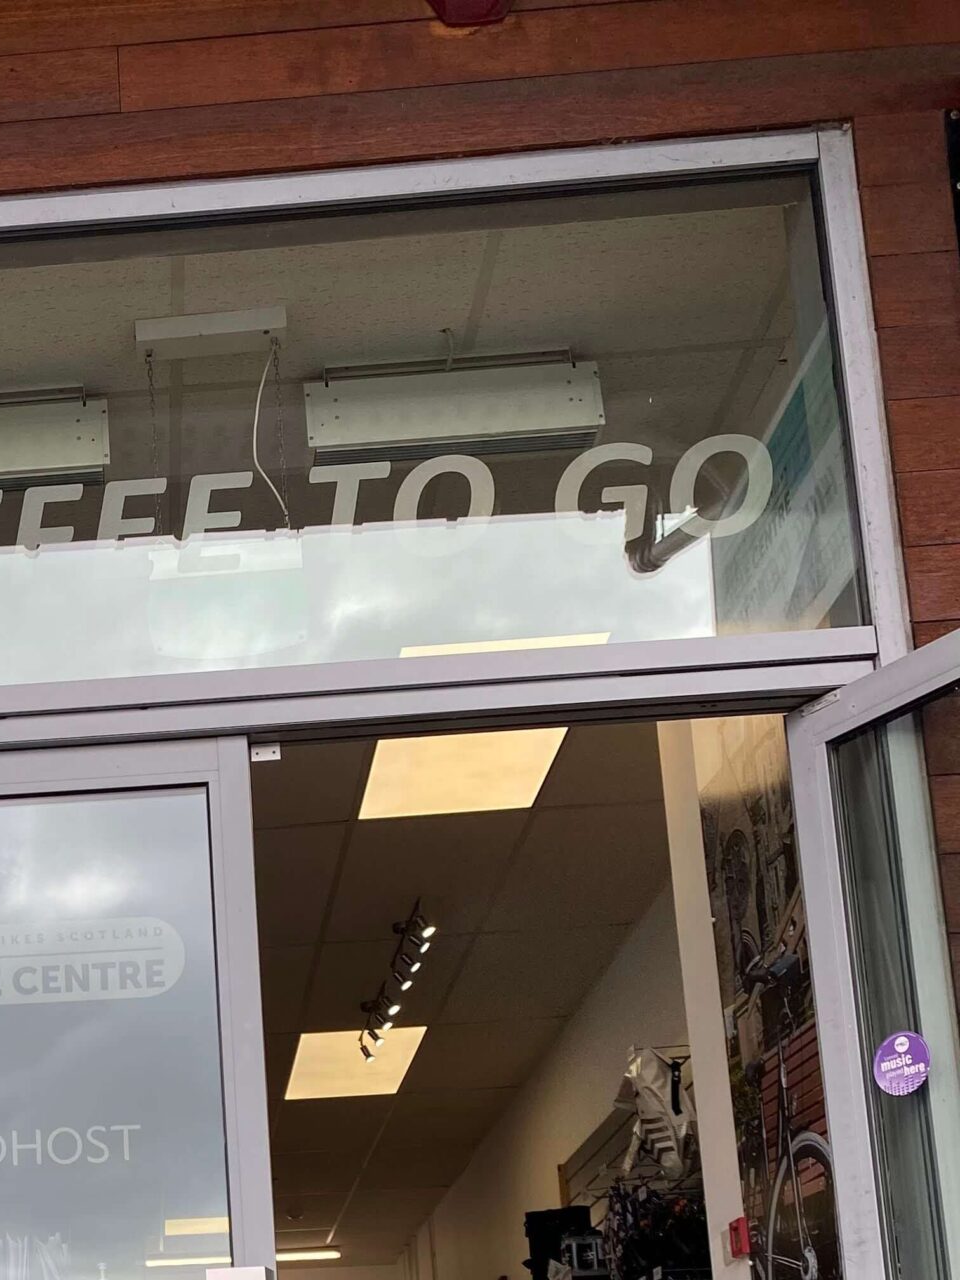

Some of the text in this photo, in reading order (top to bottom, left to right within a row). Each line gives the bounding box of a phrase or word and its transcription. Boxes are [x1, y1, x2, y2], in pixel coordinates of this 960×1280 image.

[309, 454, 496, 556] TO
[554, 433, 774, 542] GO
[56, 926, 164, 942] SCOTLAND
[12, 959, 166, 996] CENTRE
[881, 1053, 913, 1072] music
[904, 1062, 926, 1076] here
